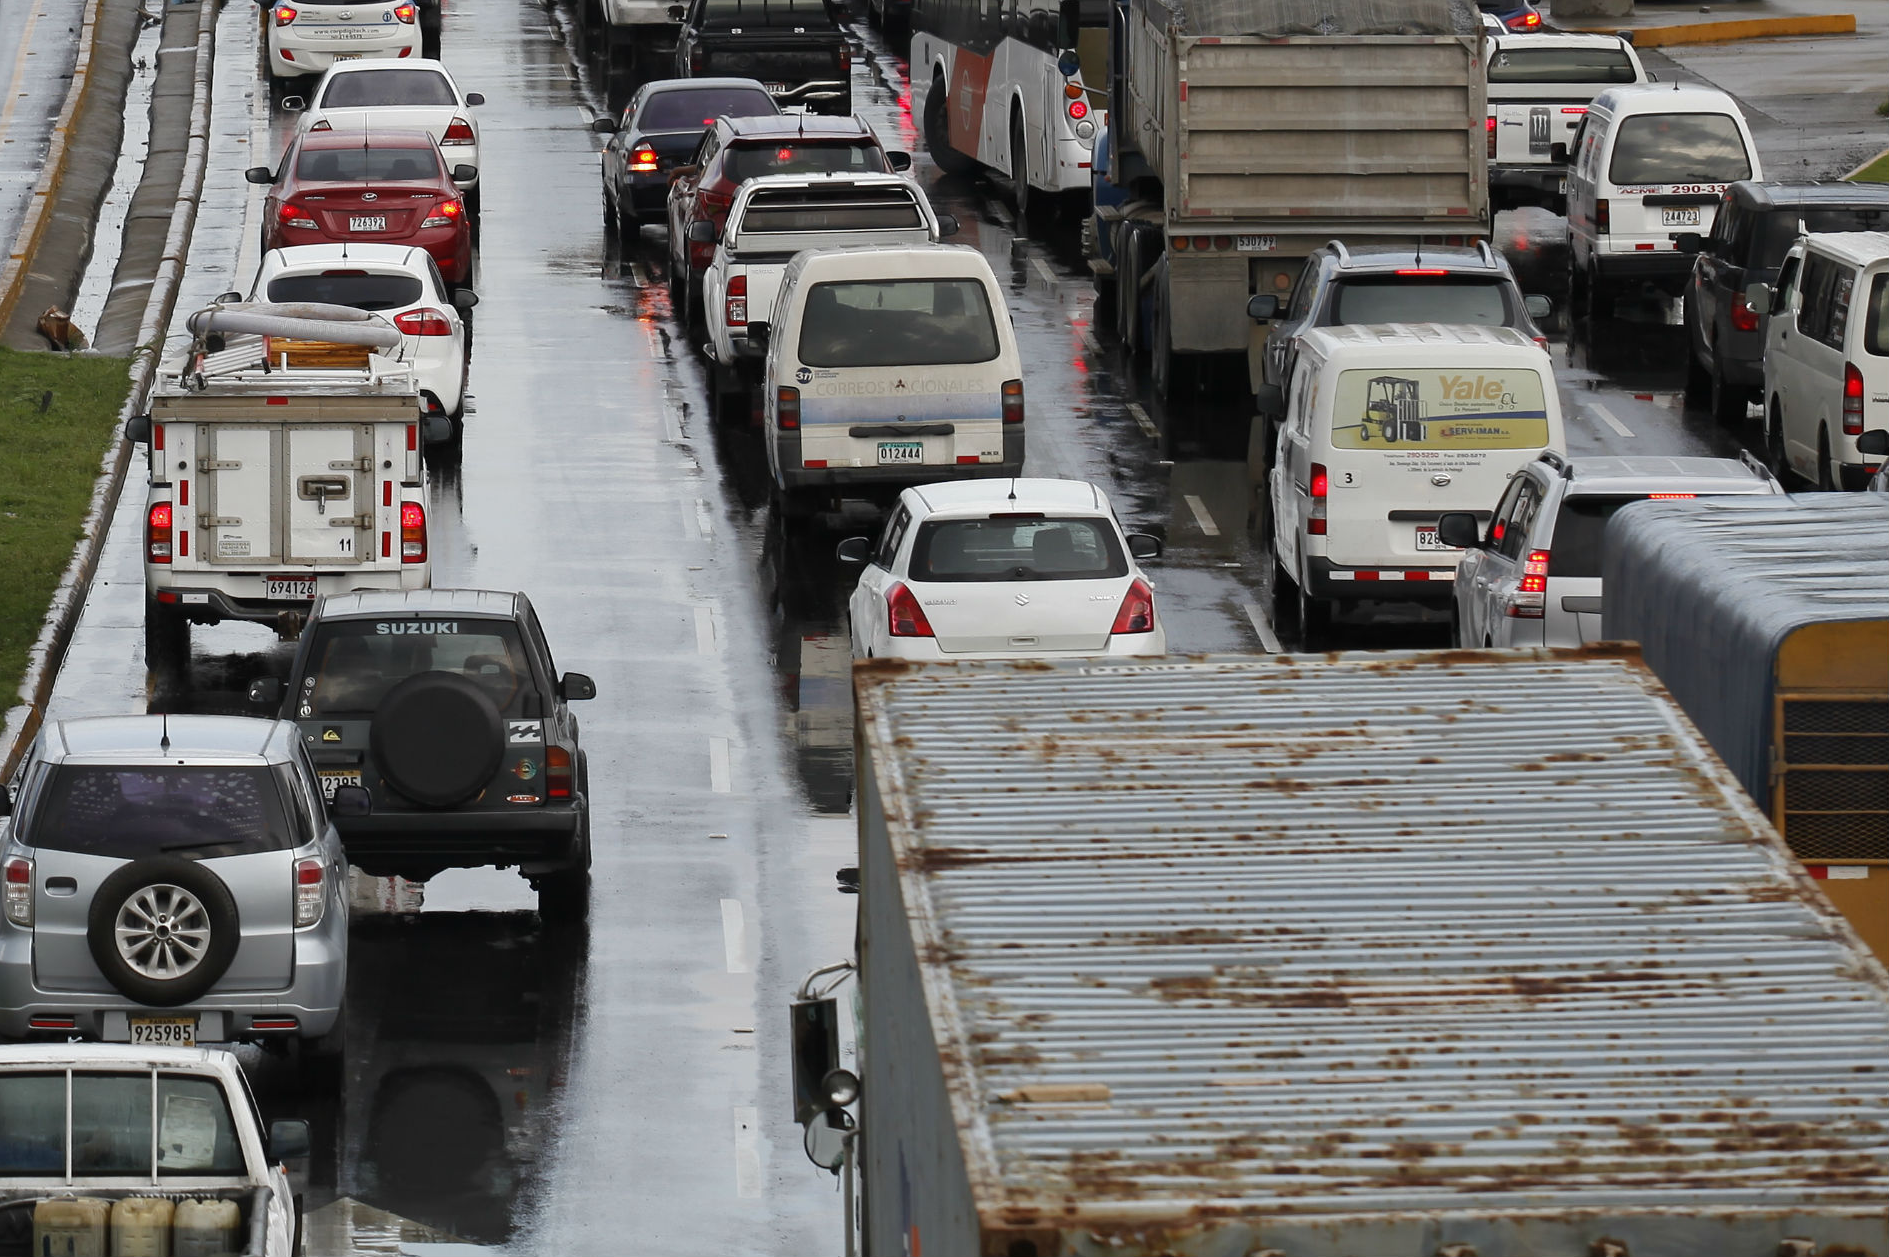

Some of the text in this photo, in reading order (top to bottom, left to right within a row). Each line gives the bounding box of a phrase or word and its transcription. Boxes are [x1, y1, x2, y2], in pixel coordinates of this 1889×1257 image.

[352, 218, 383, 227] 726392
[1664, 211, 1698, 222] 244723
[1240, 236, 1274, 247] 530799
[816, 378, 984, 397] CORREOS NACIONALES
[1439, 375, 1503, 401] Yale
[1449, 427, 1500, 435] SERV-IMAN
[881, 447, 920, 459] 012444
[1344, 472, 1353, 484] 3
[339, 538, 351, 552] 11
[270, 581, 314, 595] 694126
[376, 622, 458, 635] SUZUKI
[135, 1025, 192, 1042] 925985
